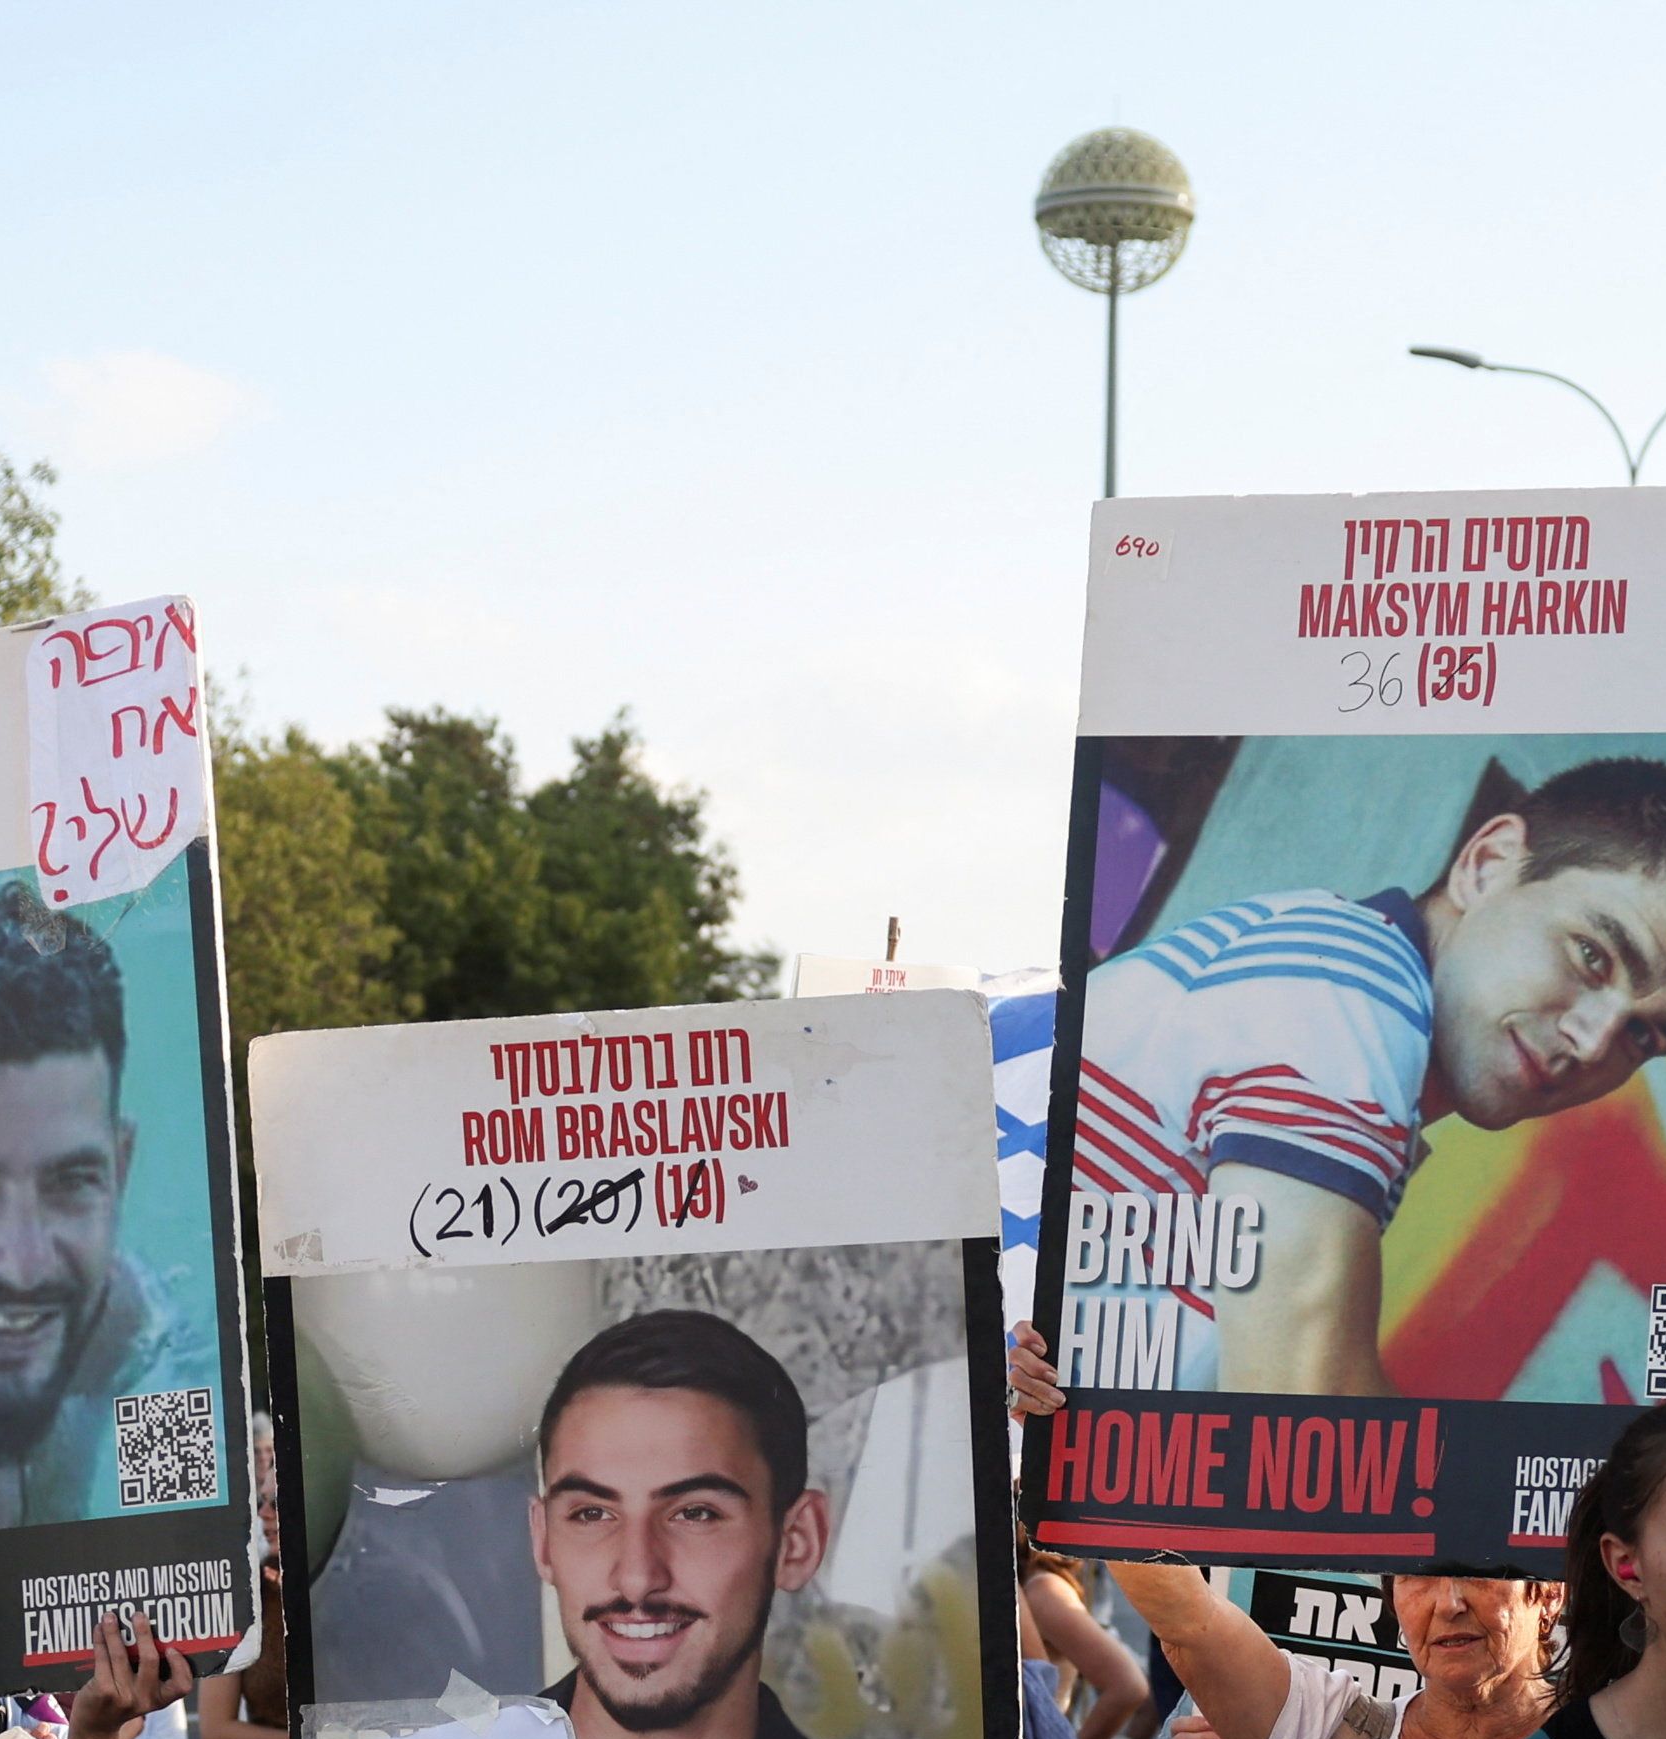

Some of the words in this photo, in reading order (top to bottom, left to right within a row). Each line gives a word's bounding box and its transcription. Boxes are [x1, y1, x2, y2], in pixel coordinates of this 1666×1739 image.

[1114, 533, 1160, 559] 690
[1343, 518, 1449, 580] הרקין
[1463, 516, 1590, 579] מקסים
[1298, 583, 1470, 639] MAKSYM
[1481, 578, 1629, 636] HARKIN
[42, 602, 197, 689] איפה
[1337, 650, 1403, 713] 36
[1416, 642, 1498, 708] (35)
[111, 687, 197, 759] אח
[490, 1033, 678, 1104] ברסלבסקי
[690, 1028, 752, 1088] רום
[462, 1107, 544, 1167] ROM
[557, 1091, 789, 1160] BRASLAVSKI
[410, 1177, 521, 1257] (21)
[1065, 1191, 1261, 1288] BRING
[1058, 1295, 1180, 1391] HIM
[1047, 1407, 1231, 1506] HOME
[1246, 1406, 1441, 1518] NOW!
[1515, 1455, 1608, 1489] HOSTAG
[21, 1571, 111, 1609] HOSTAGES
[113, 1567, 149, 1600] AND
[153, 1558, 232, 1596] MISSING
[1288, 1586, 1383, 1645] את
[141, 1591, 235, 1644] FORUM
